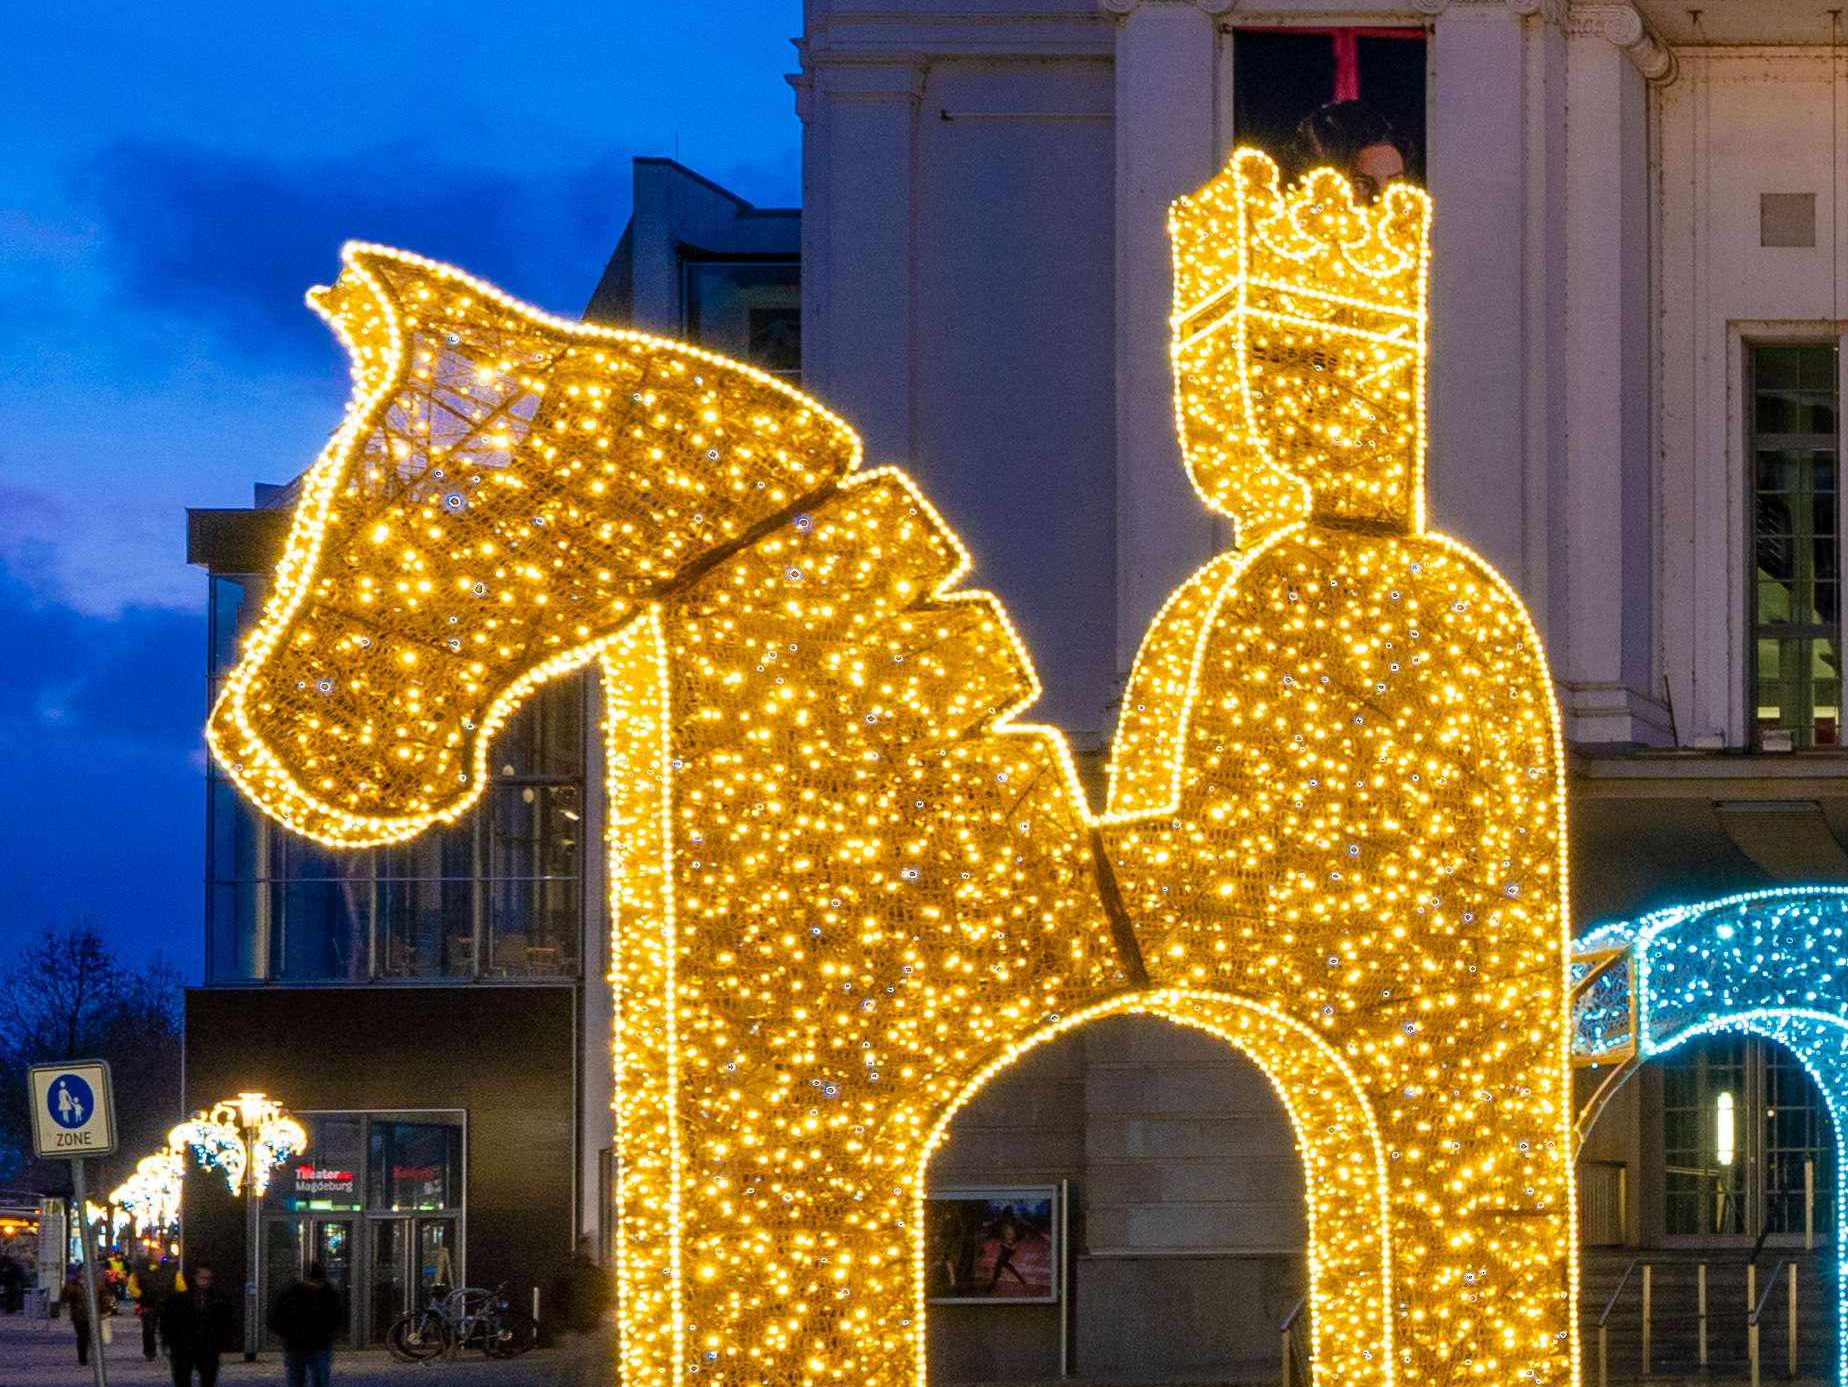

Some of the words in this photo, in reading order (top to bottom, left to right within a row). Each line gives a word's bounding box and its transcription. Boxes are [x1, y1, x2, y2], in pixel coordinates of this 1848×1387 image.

[56, 1131, 92, 1146] ZONE
[295, 1168, 340, 1180] Theater
[295, 1181, 353, 1193] Magdeburg
